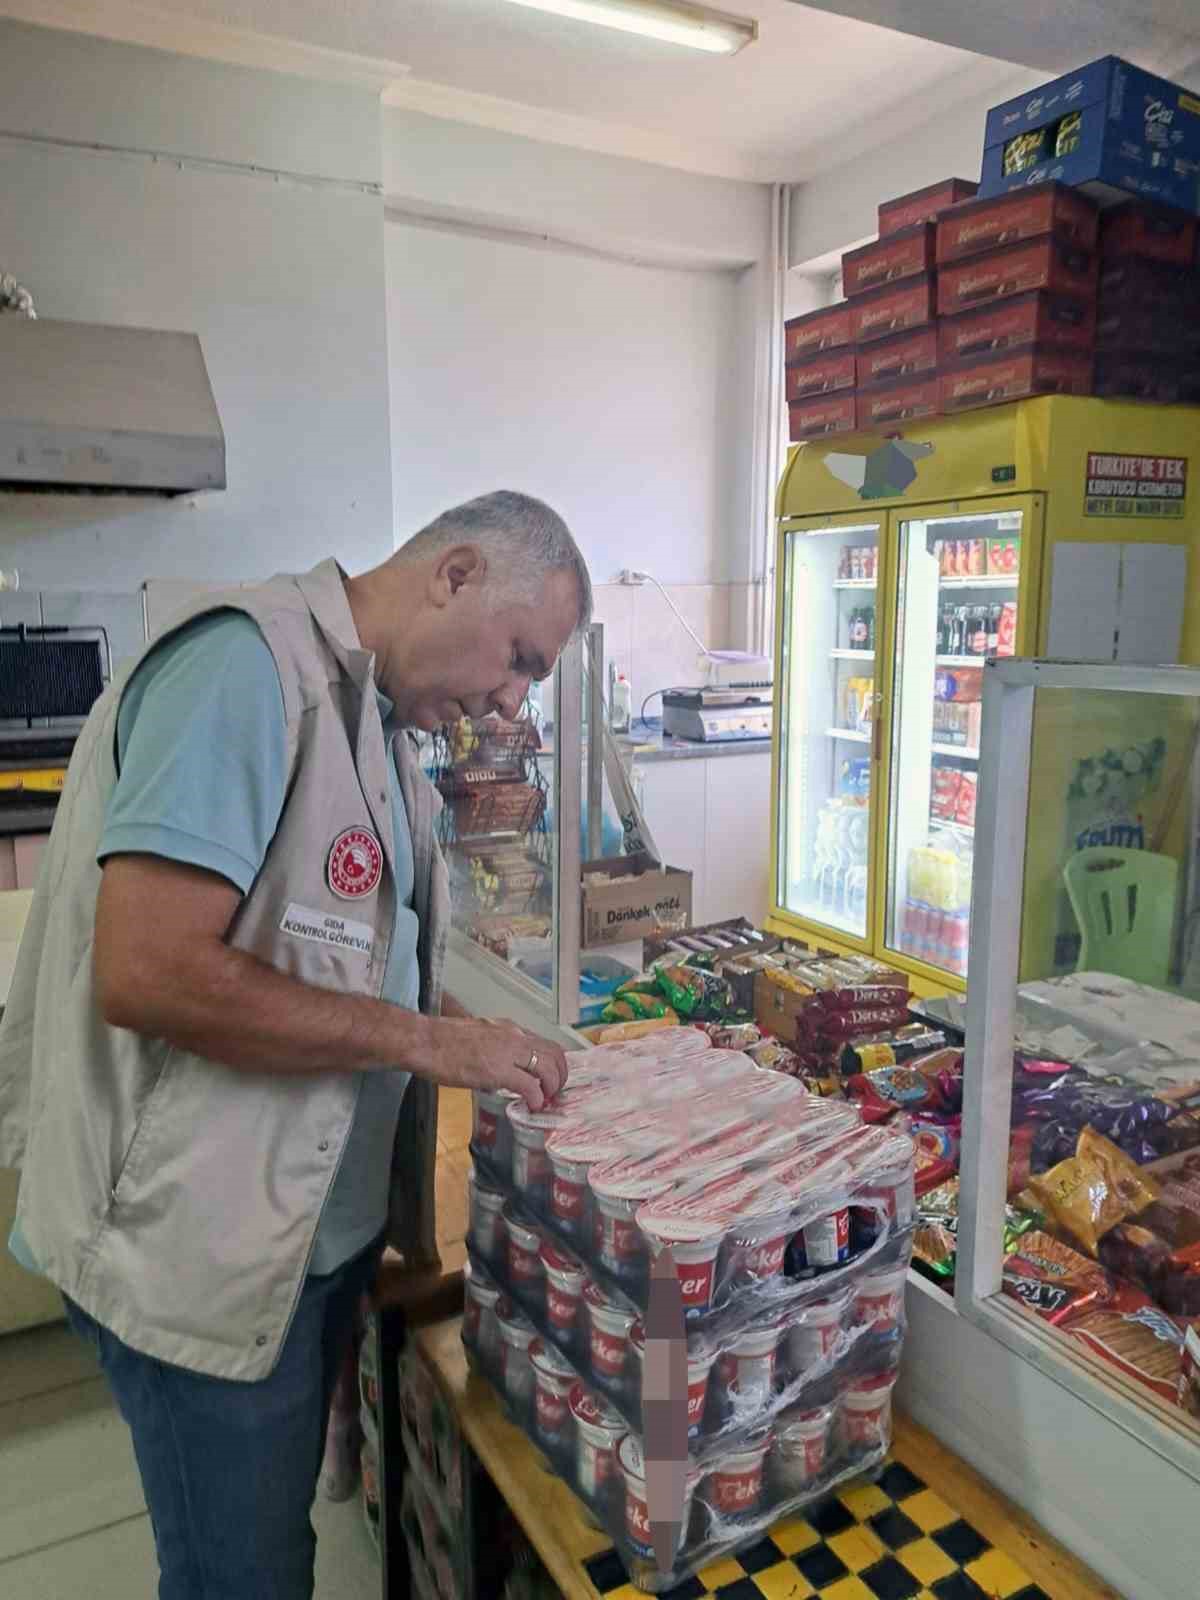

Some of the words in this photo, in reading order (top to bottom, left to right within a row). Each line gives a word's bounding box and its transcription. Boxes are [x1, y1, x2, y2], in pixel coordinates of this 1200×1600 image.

[1157, 458, 1184, 479] TEK
[283, 919, 327, 939] KONTROL
[324, 917, 345, 930] GIDA
[678, 1276, 706, 1295] er
